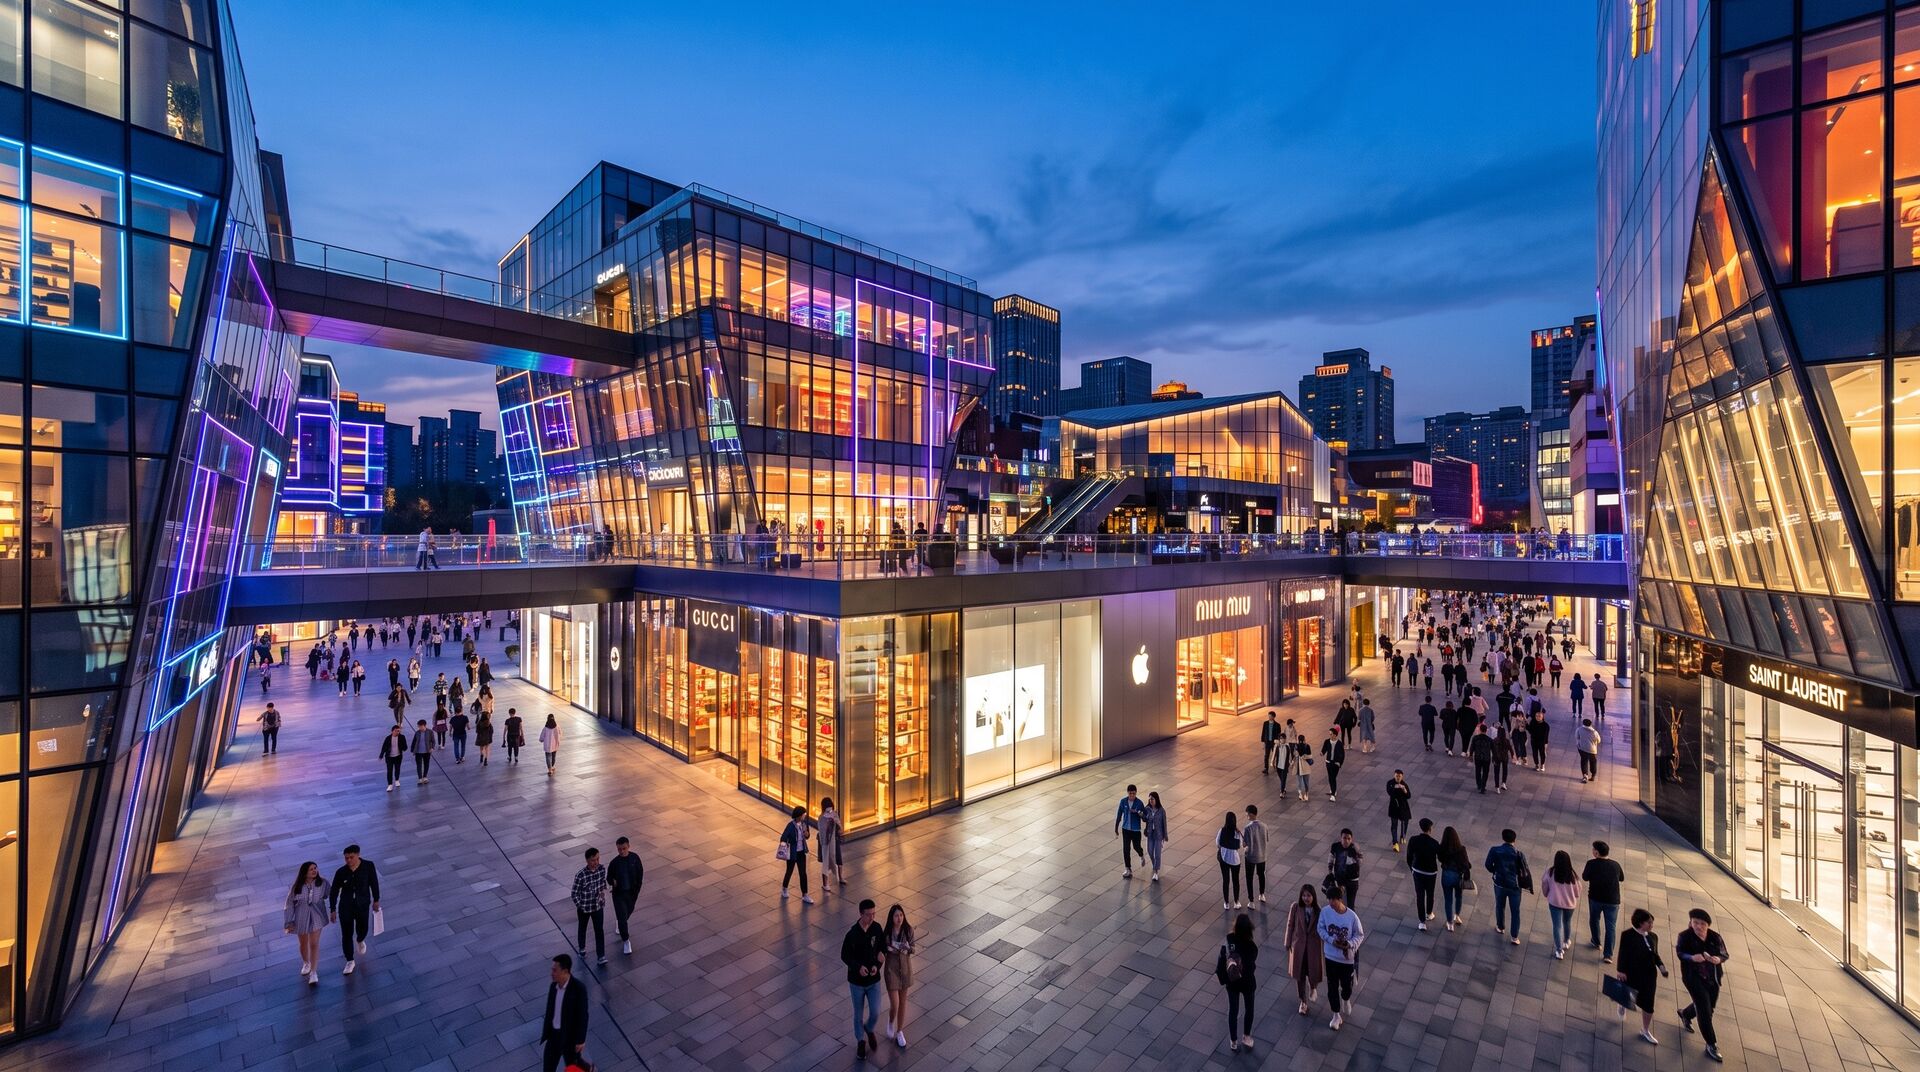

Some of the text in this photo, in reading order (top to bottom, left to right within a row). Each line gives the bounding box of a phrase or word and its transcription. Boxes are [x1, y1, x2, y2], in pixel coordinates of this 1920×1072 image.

[693, 608, 734, 632] GUCCI
[1196, 595, 1251, 621] MIU MIU
[1749, 663, 1848, 712] SAINT LAURENT
